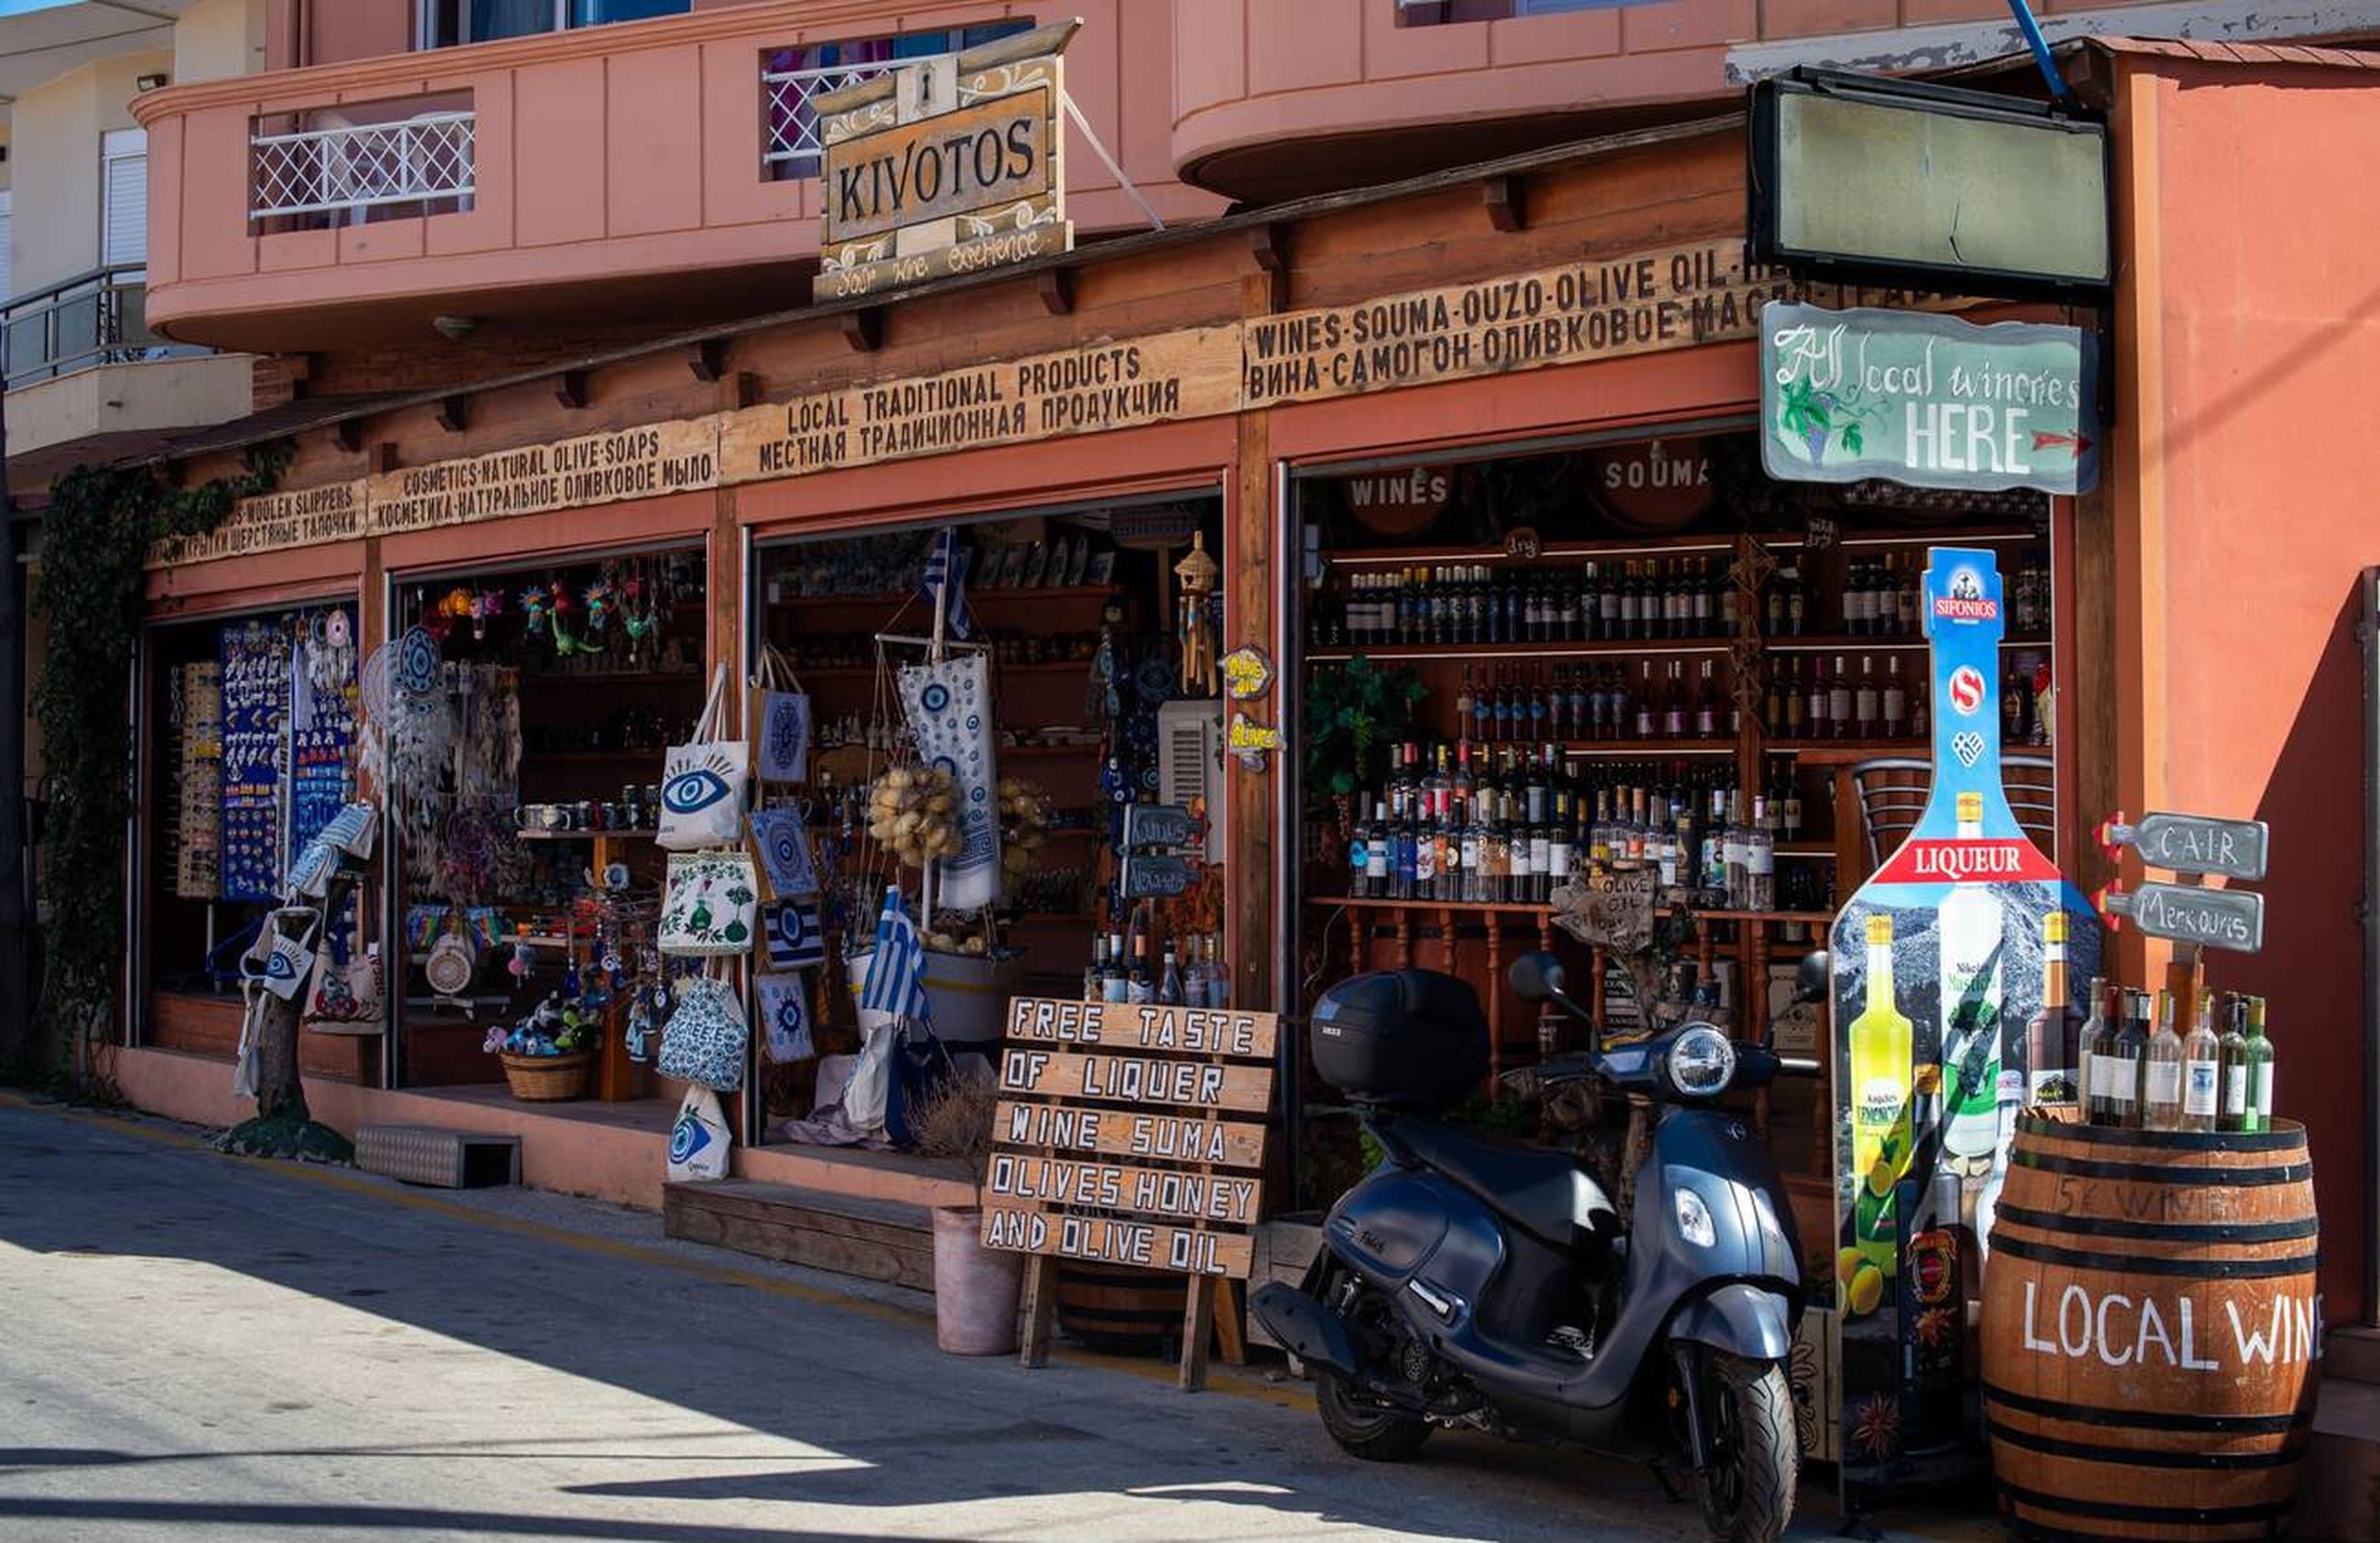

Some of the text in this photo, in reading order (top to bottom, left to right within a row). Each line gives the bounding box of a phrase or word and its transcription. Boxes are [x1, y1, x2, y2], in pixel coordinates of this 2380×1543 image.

[838, 118, 1034, 222] KIVOTOS
[1671, 248, 1726, 295] OIL
[787, 346, 1141, 435] LOCAL TRADITIONAL PRODUCTS
[1774, 322, 2081, 411] All local wineries
[759, 377, 1180, 473] МЕСТНАЯ ТРАДИЦИОННАЯ ПРОДУКЦИЯ
[1906, 401, 2031, 475] HERE
[663, 452, 712, 486] МЫЛО
[1351, 474, 1448, 507] WINES
[1605, 459, 1713, 491] SOUMA
[296, 485, 353, 514] SLIPPERS
[303, 512, 356, 539] ТАПОЧКИ
[1935, 599, 1997, 619] SIFONIOS
[1603, 878, 1649, 893] OLIVE
[1914, 846, 2022, 879] LIQUEUR
[1012, 998, 1255, 1054] FREE TASTE
[1006, 1050, 1225, 1104] OF LIQUER
[1011, 1105, 1226, 1162] WINE SUMA
[992, 1154, 1255, 1221] OLIVES HONEY
[987, 1210, 1227, 1276] AND OLIVE OIL
[2024, 1280, 2220, 1372] LOCAL
